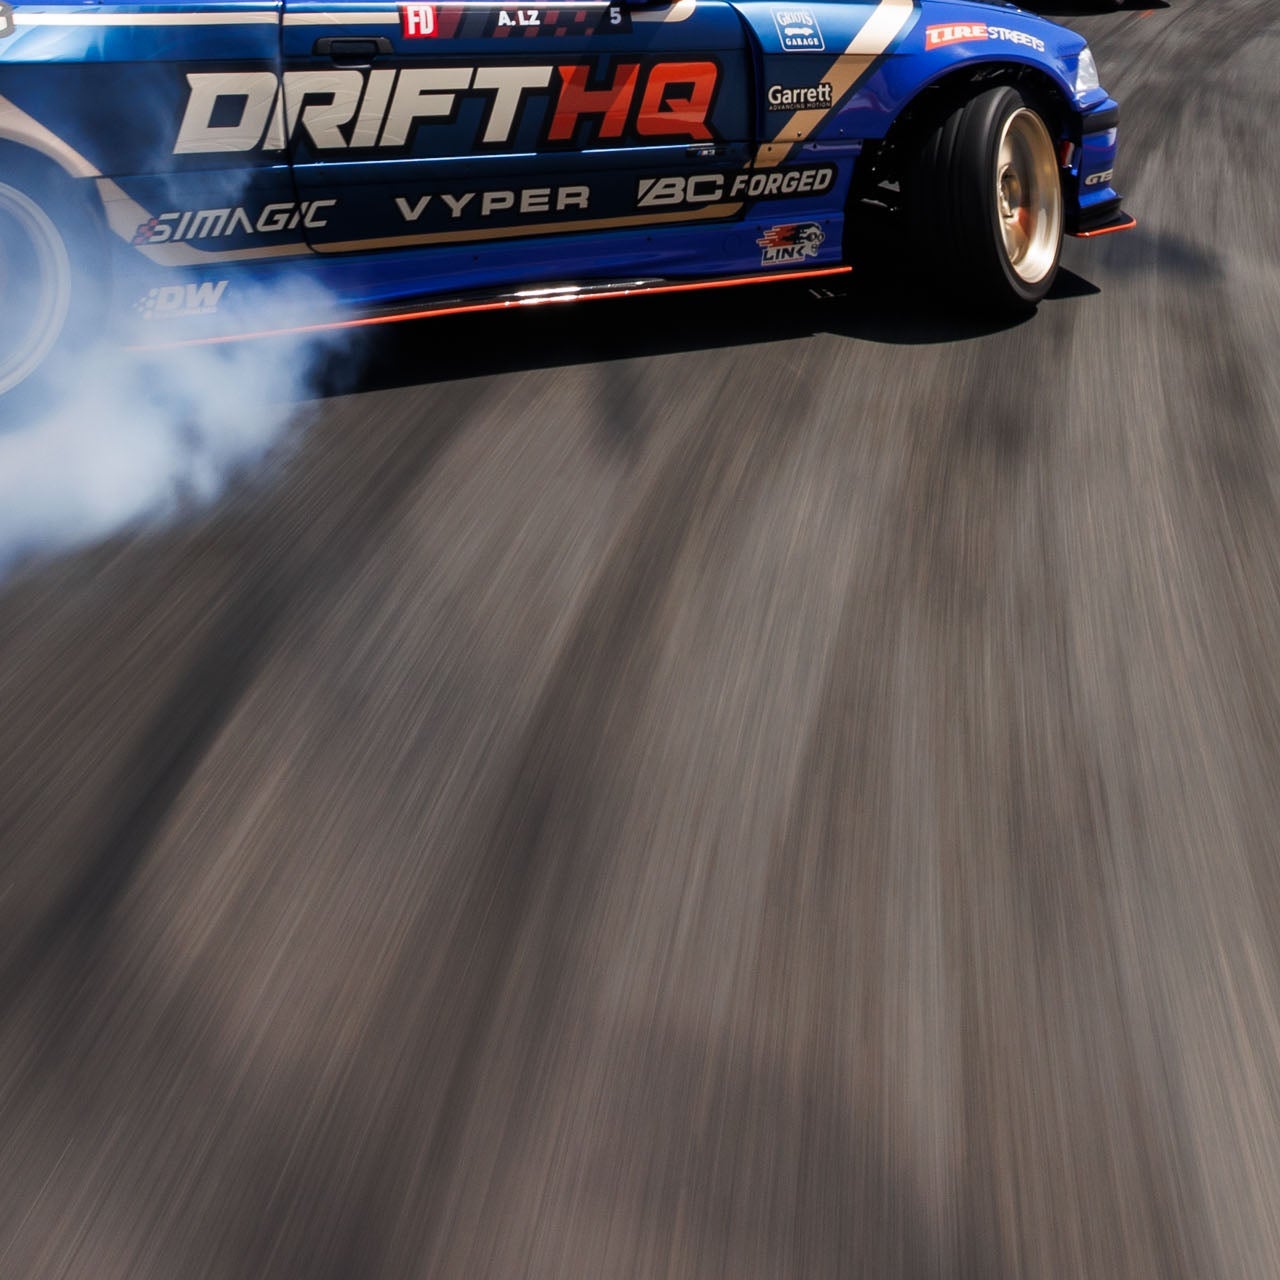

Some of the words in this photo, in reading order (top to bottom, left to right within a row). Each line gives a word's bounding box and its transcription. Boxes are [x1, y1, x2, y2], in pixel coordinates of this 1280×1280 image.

[407, 5, 435, 34] FD
[609, 7, 622, 25] 5
[785, 37, 820, 46] GARAGE
[768, 84, 831, 104] Garrett
[769, 103, 805, 111] ADVANCING
[730, 168, 834, 197] FORGED
[396, 185, 591, 220] VYPER
[148, 199, 338, 243] SIMAGIC
[156, 280, 230, 311] DW
